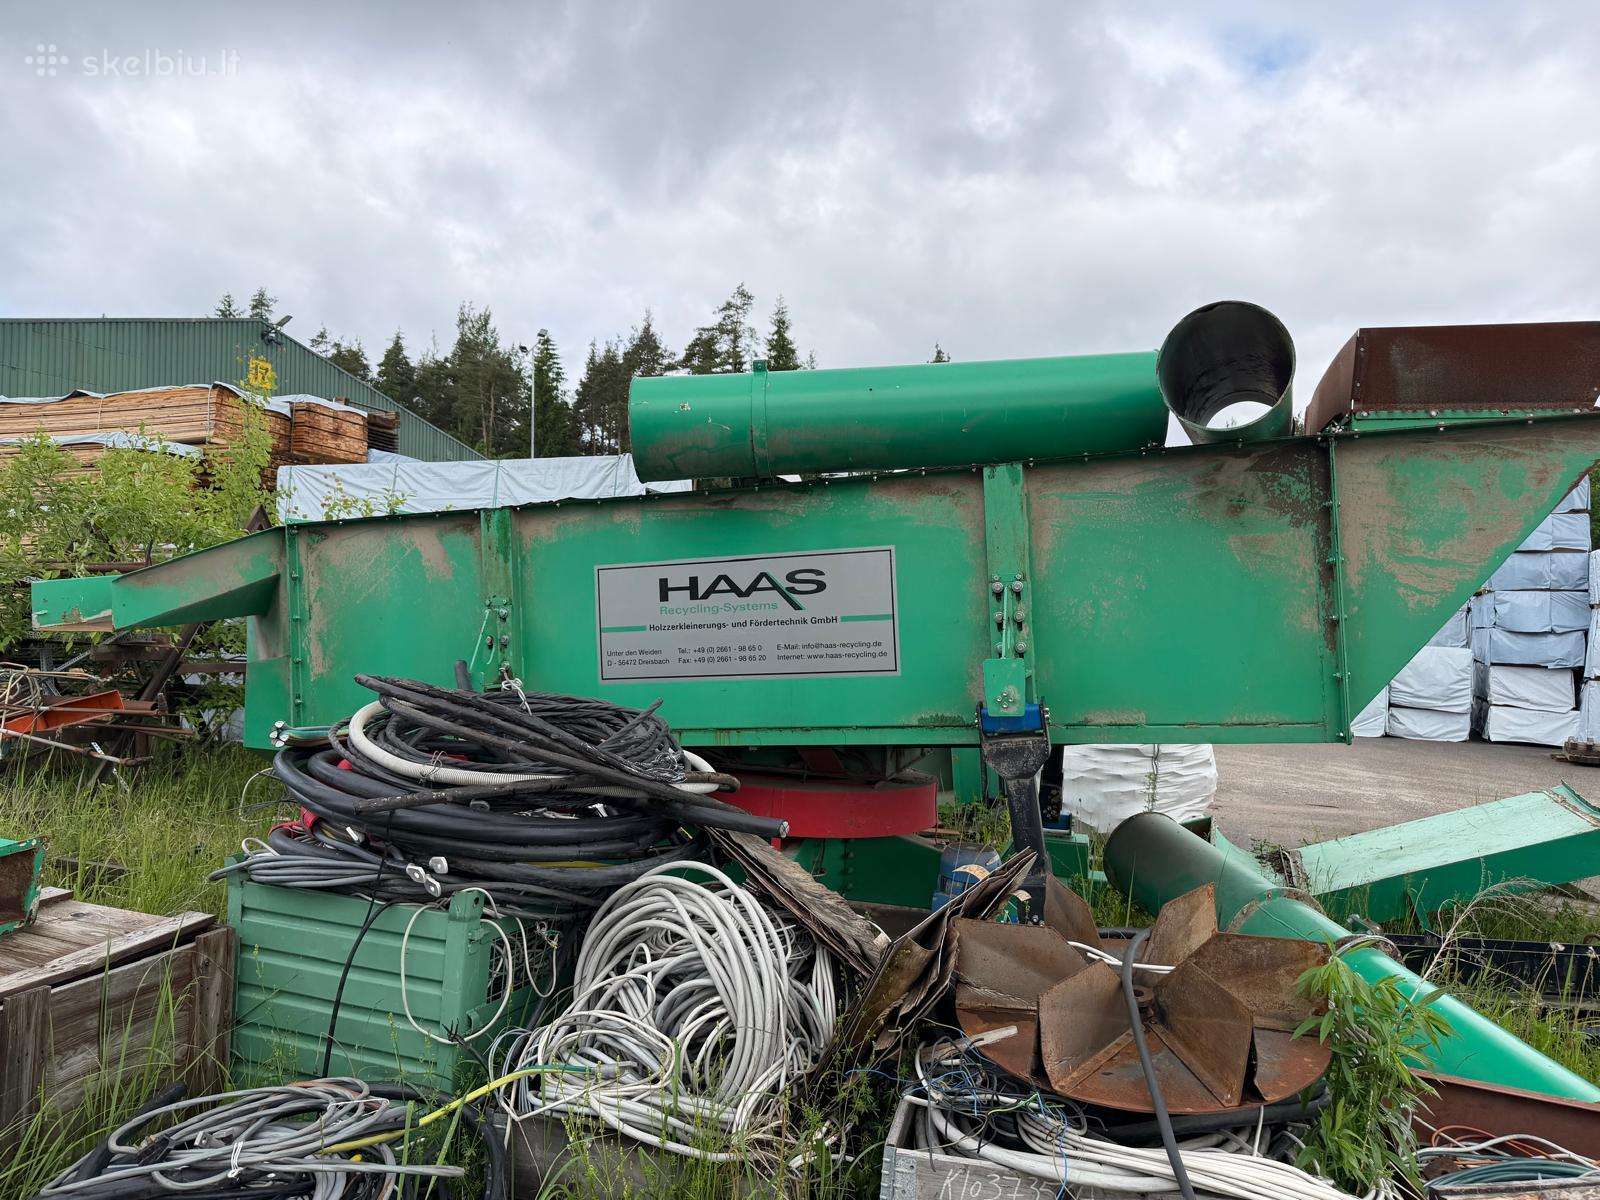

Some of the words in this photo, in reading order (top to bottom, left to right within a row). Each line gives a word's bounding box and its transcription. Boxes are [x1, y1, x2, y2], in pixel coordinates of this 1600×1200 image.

[658, 568, 827, 611] HAAS
[659, 601, 778, 617] Recycling-Systems
[649, 622, 729, 633] Holzzerkleinerungs-
[731, 620, 748, 629] und
[749, 618, 808, 628] Fördertechnik
[810, 615, 838, 625] GmbH
[776, 643, 800, 651] E-Mail:
[801, 640, 882, 650] info@haas-recycling.de
[777, 653, 805, 661] Internet:
[806, 650, 888, 660] www.haas-recycling.de
[607, 659, 613, 667] D
